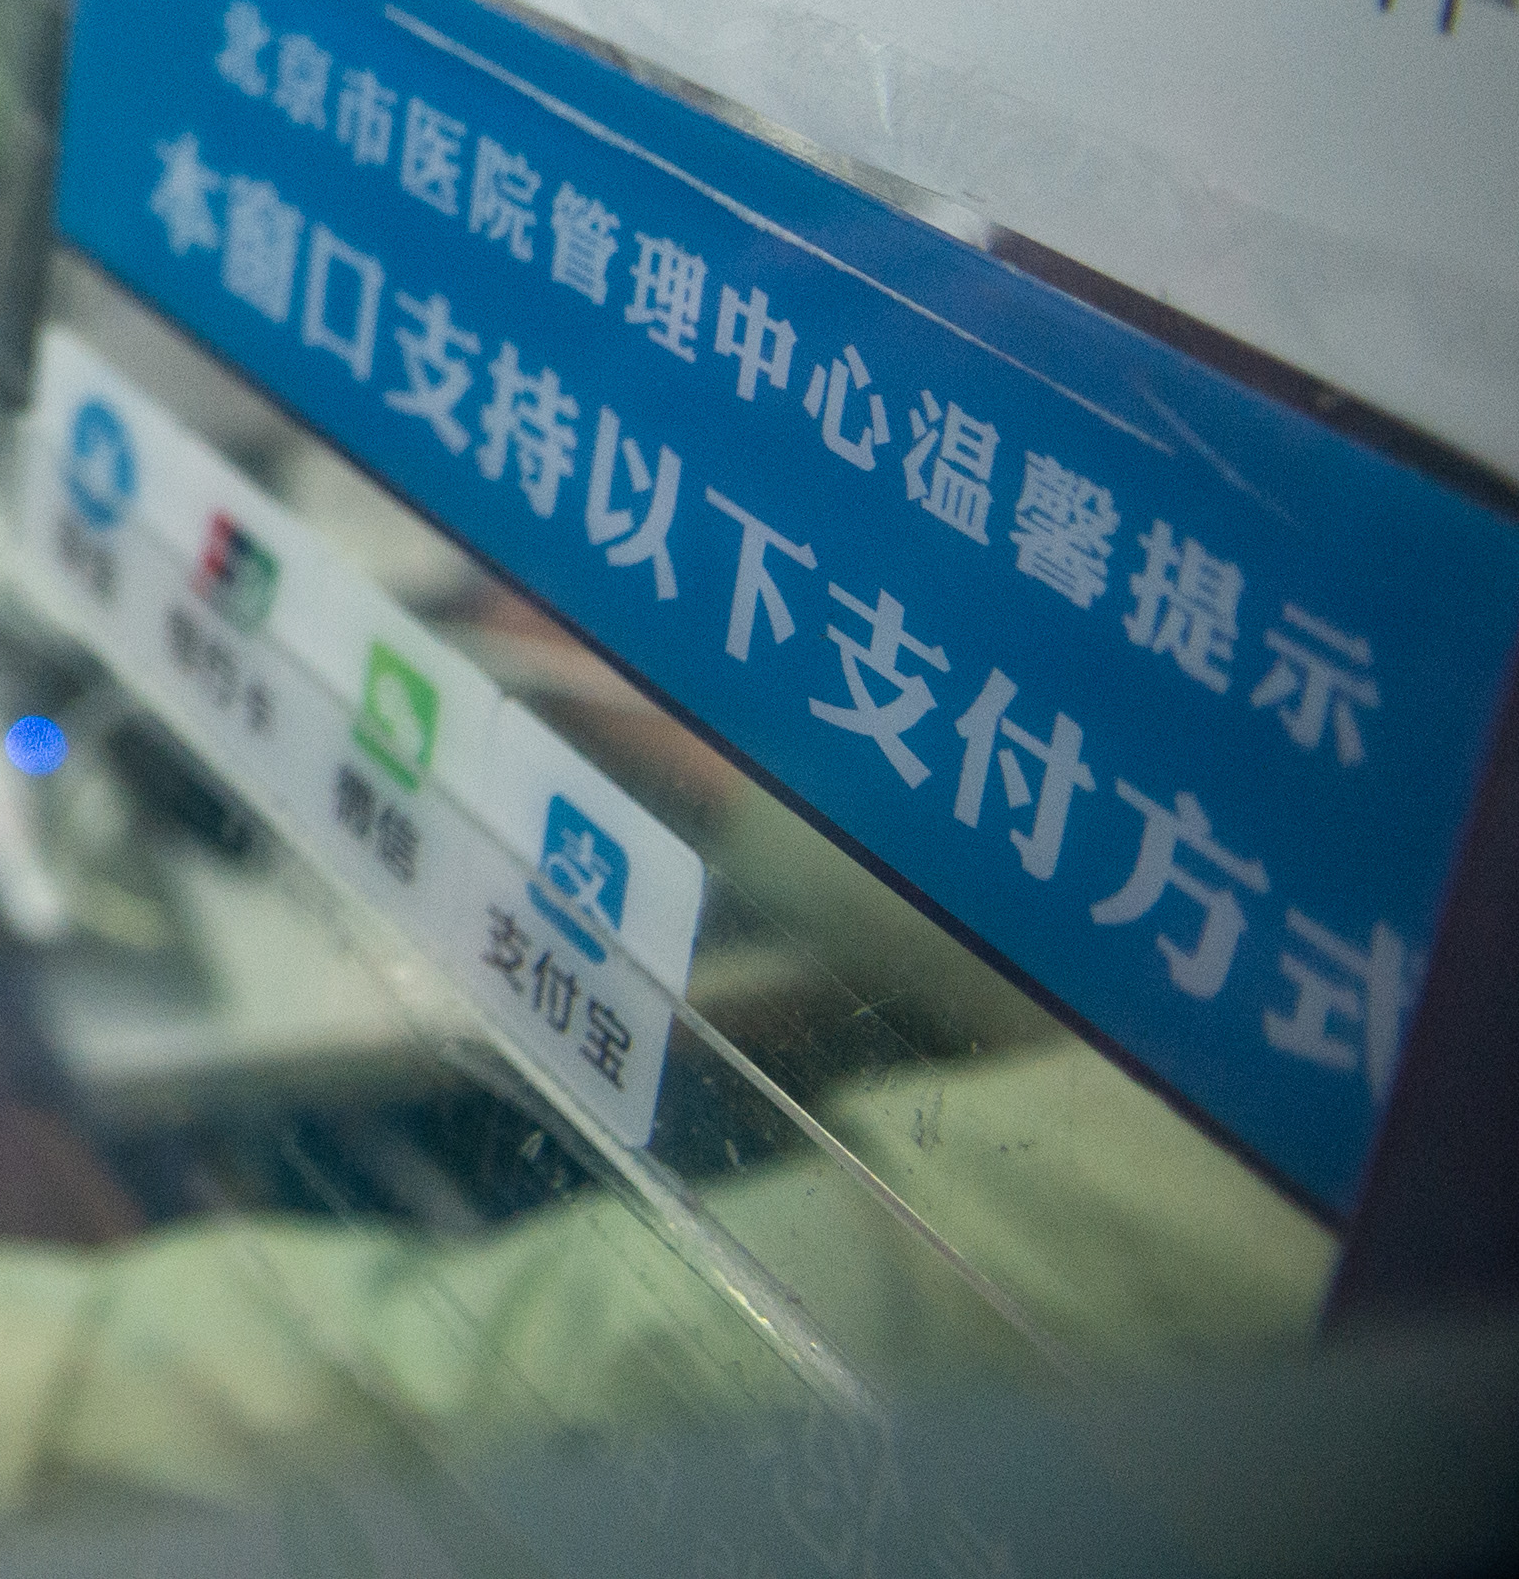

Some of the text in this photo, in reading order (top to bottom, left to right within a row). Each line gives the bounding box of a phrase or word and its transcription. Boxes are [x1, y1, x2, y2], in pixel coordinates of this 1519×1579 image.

[149, 130, 1433, 1106] 本窗口支持以下支付方式
[480, 902, 634, 1091] 支付宝
